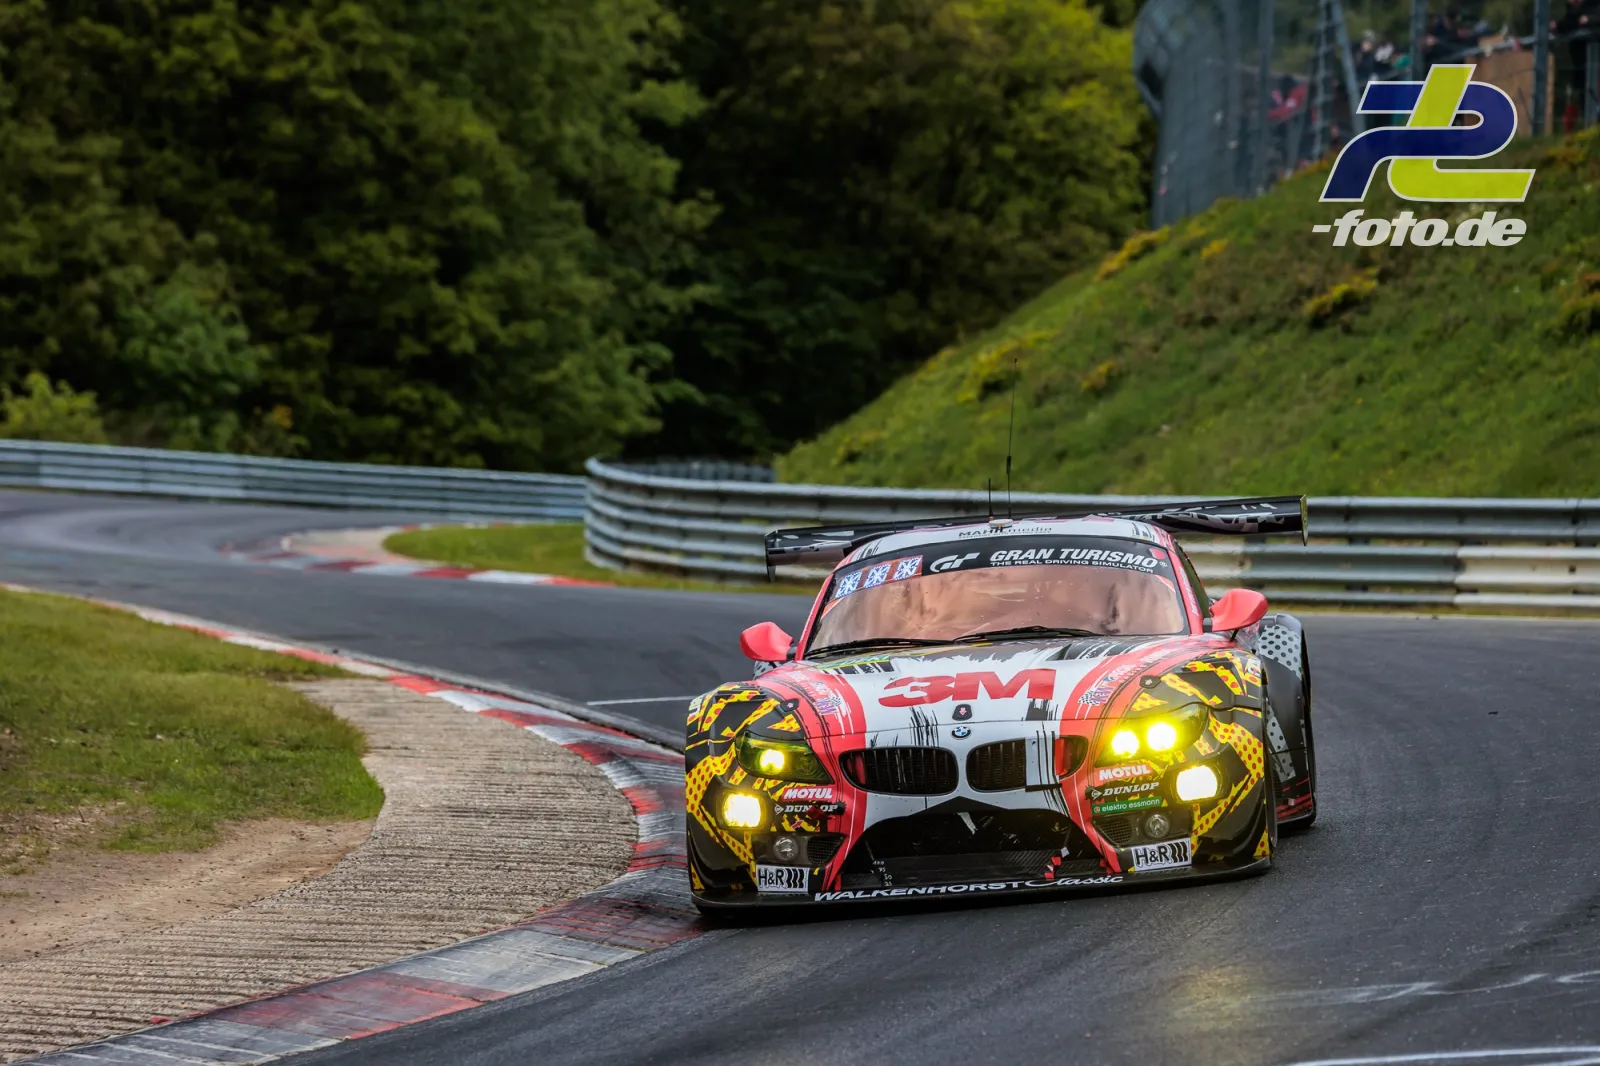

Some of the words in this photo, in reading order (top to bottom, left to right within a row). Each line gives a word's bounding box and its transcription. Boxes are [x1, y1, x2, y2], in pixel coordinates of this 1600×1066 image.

[990, 548, 1056, 562] GRAN
[1060, 548, 1159, 568] TURISMO
[1092, 560, 1154, 574] SIMULATOR
[878, 668, 1057, 708] 3M
[1099, 764, 1150, 781] MOTUL
[784, 788, 832, 799] MOTUL
[1102, 782, 1160, 796] DUNLOP
[784, 804, 838, 813] DUNOP
[1101, 802, 1127, 812] elektro
[1128, 798, 1161, 808] essmann
[1135, 845, 1170, 867] H&R
[758, 868, 787, 888] H&R
[814, 882, 1027, 902] WALKENHORST
[1025, 875, 1124, 887] Classic
